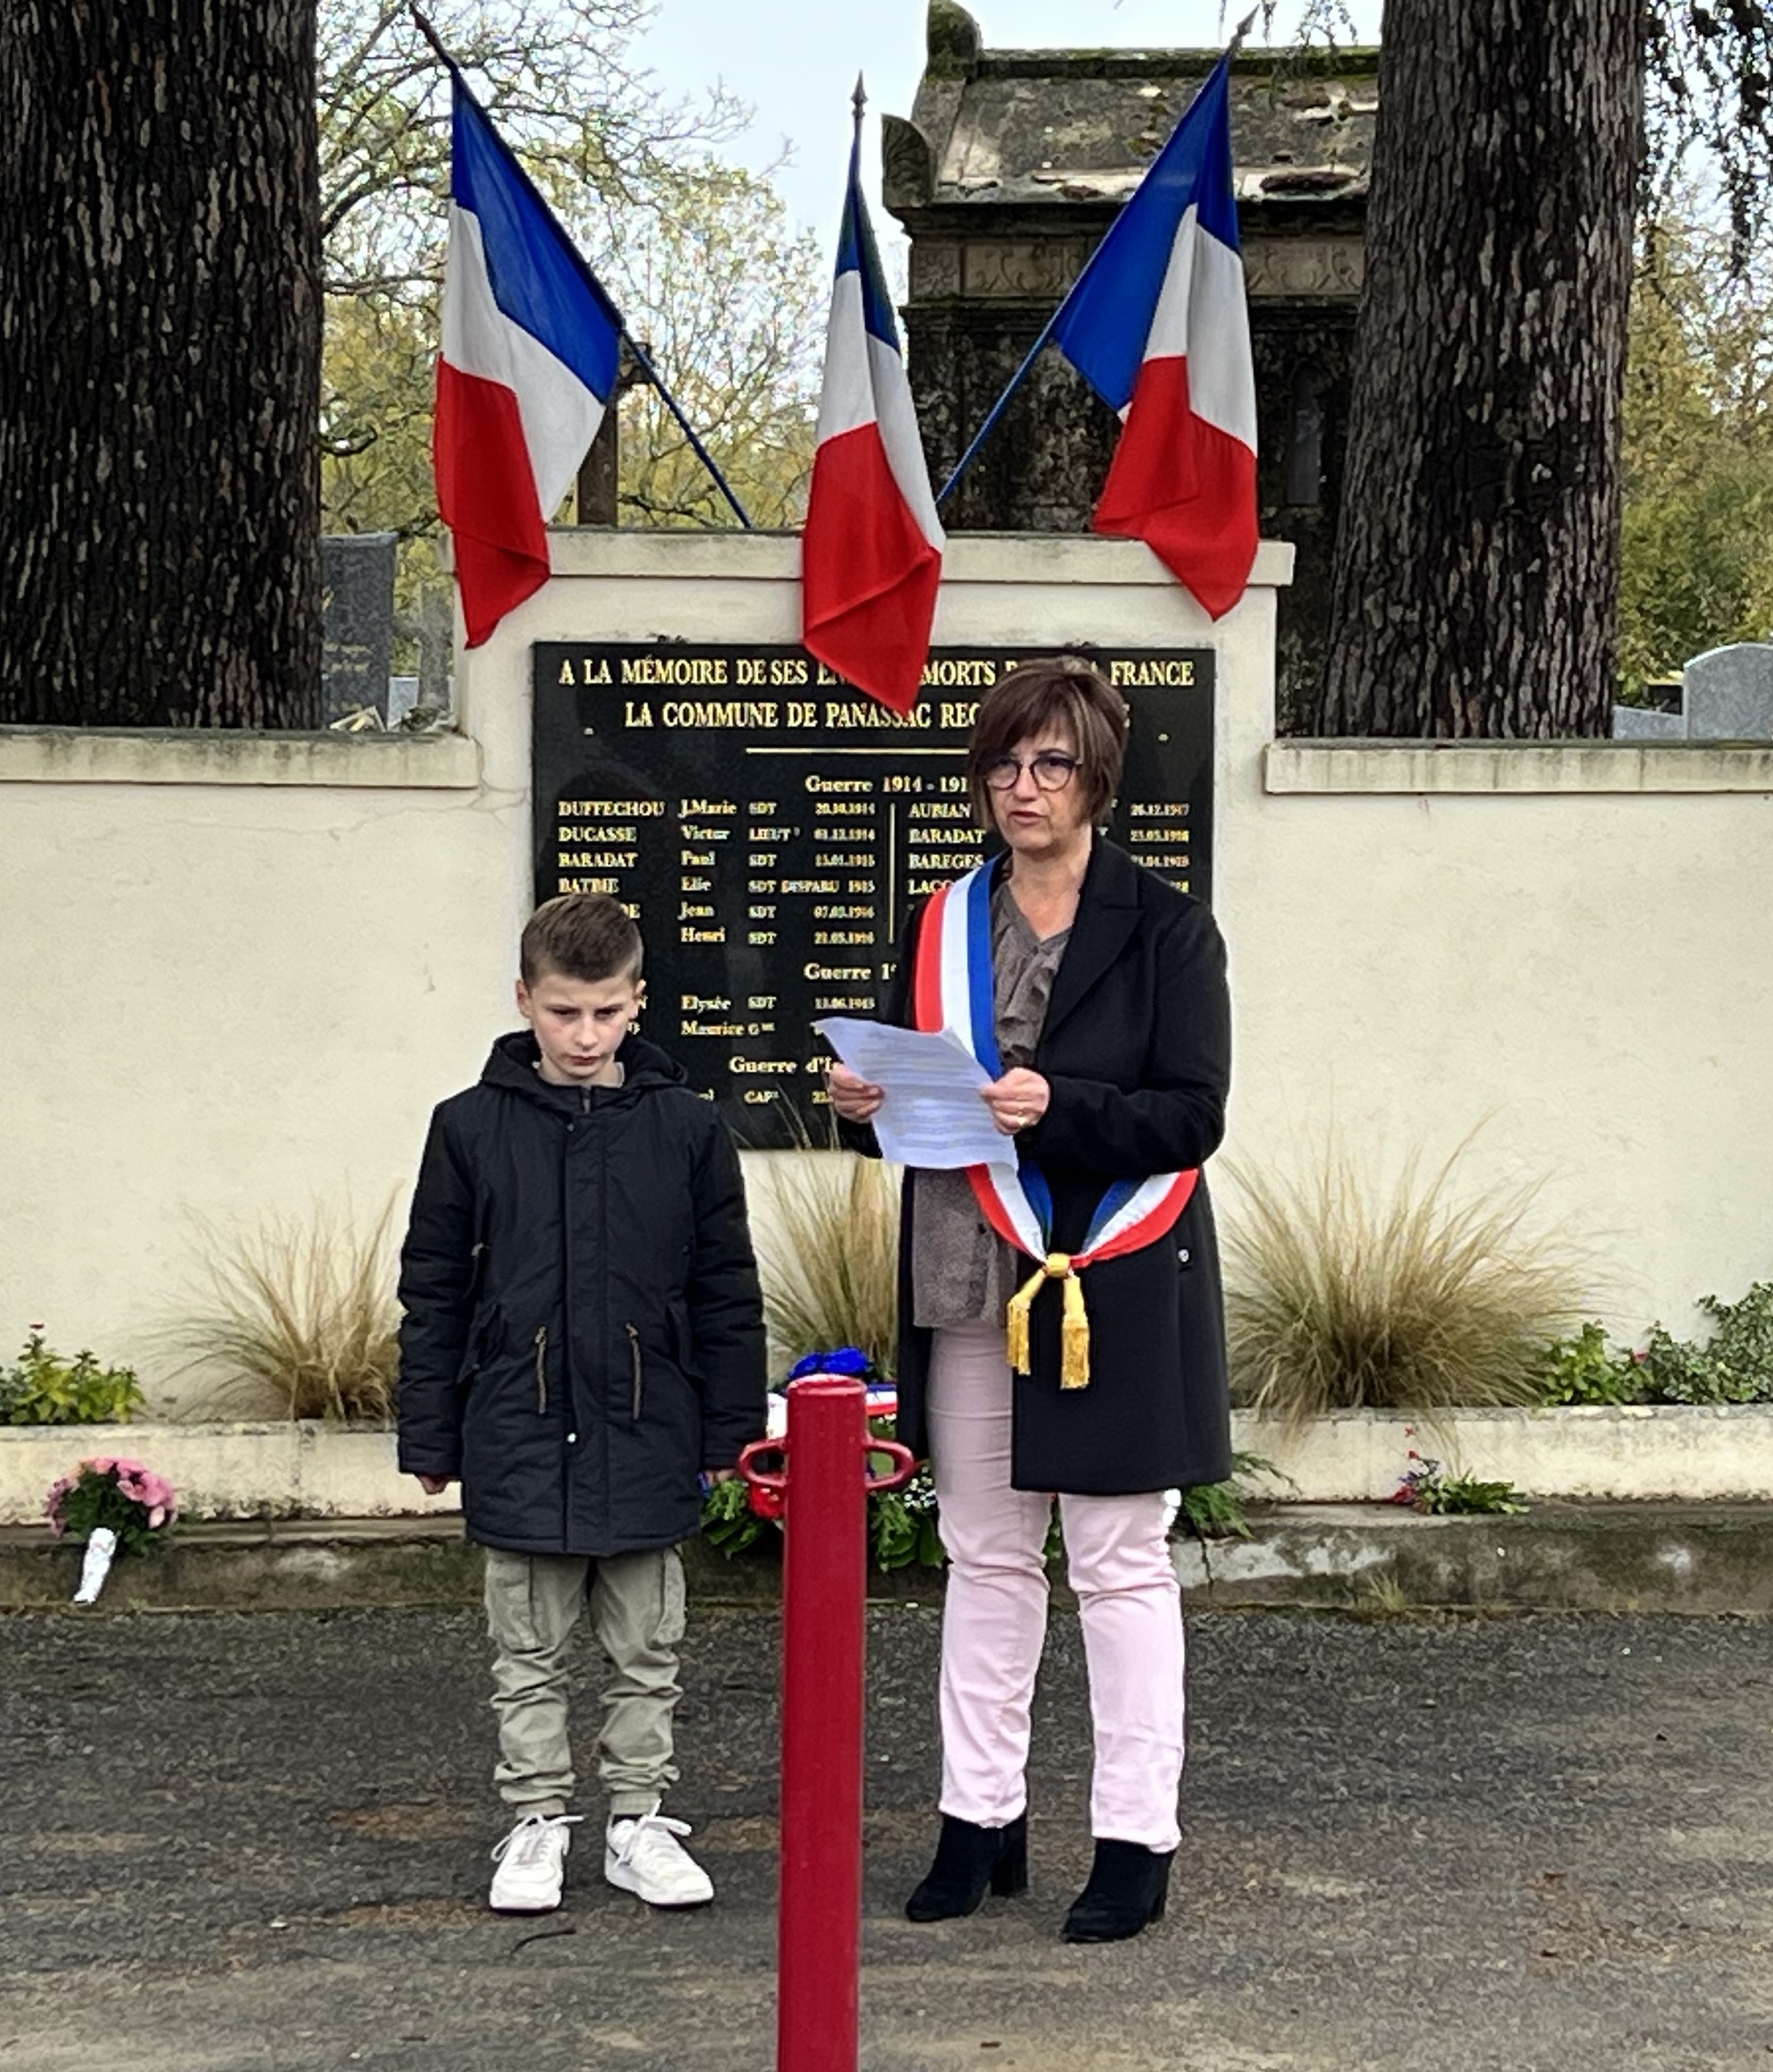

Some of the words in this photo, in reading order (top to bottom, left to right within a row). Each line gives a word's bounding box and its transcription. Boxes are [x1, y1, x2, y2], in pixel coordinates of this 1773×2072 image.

[559, 660, 575, 684] A
[584, 660, 612, 684] LA
[621, 654, 728, 685] MÉMOIRE
[736, 660, 767, 685] DE
[771, 661, 808, 685] SES
[920, 661, 996, 686] MORTS
[1111, 661, 1194, 686] FRANCE
[625, 703, 654, 727] LA
[663, 702, 780, 728] COMMUNE
[787, 703, 818, 727] DE
[805, 775, 873, 793] Guerre
[882, 776, 922, 793] 1914
[940, 776, 968, 793] 191
[559, 801, 666, 816] DUFFECHOU
[748, 802, 777, 816] SDT
[559, 827, 637, 843] DUCASSE
[908, 829, 987, 843] BARADAT
[559, 852, 638, 868] BARADAT
[681, 850, 716, 865] Paul
[748, 854, 777, 868] SDT
[748, 879, 777, 893] SDT
[677, 901, 716, 920] Jean
[748, 905, 777, 919] SDT
[681, 926, 725, 943] Henri
[748, 931, 777, 945] SDT
[804, 963, 871, 980] Guerre
[748, 996, 777, 1009] SDT
[681, 1020, 745, 1036] Maurice
[729, 1056, 798, 1073] Guerre
